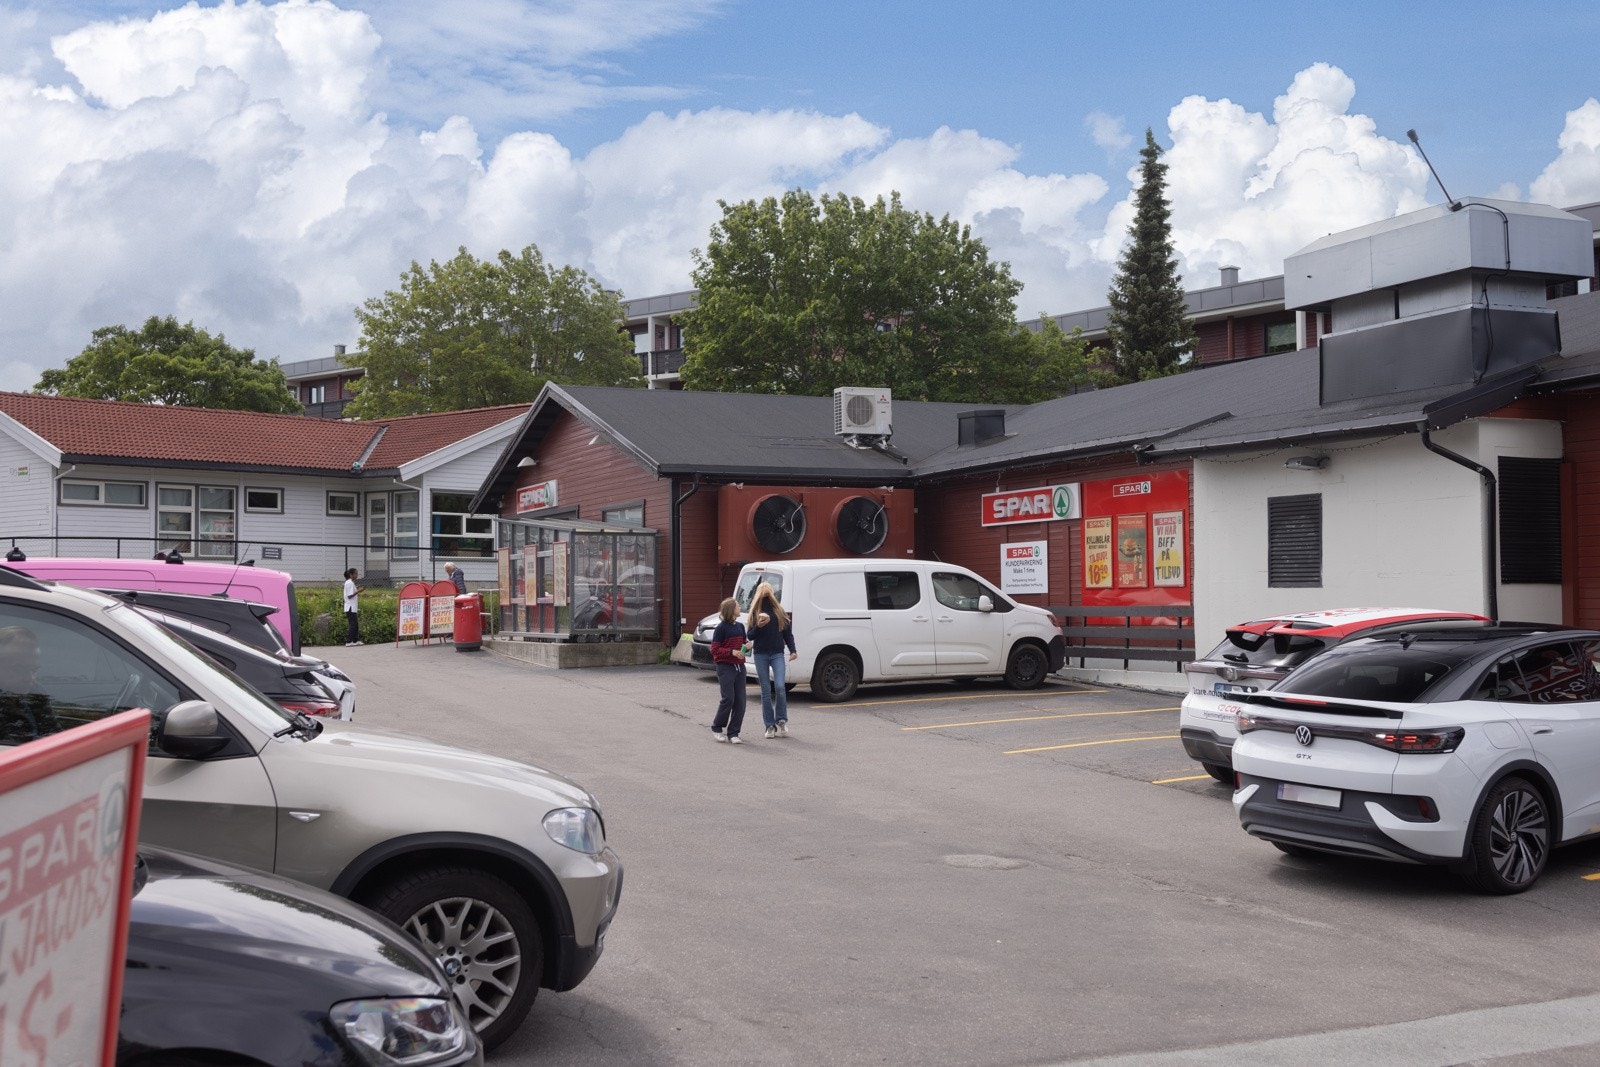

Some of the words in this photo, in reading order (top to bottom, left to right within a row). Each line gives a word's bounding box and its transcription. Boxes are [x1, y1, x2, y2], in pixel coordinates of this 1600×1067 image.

[1119, 486, 1141, 494] SPAR
[993, 494, 1050, 519] SPAR
[1156, 526, 1164, 536] VI
[1164, 525, 1177, 536] HAR
[1158, 536, 1175, 548] BIFF
[1012, 548, 1033, 557] SPAR
[1161, 548, 1171, 561] PÅ
[1005, 559, 1043, 567] KUNDEPARKERING
[1155, 565, 1181, 580] TILBUD
